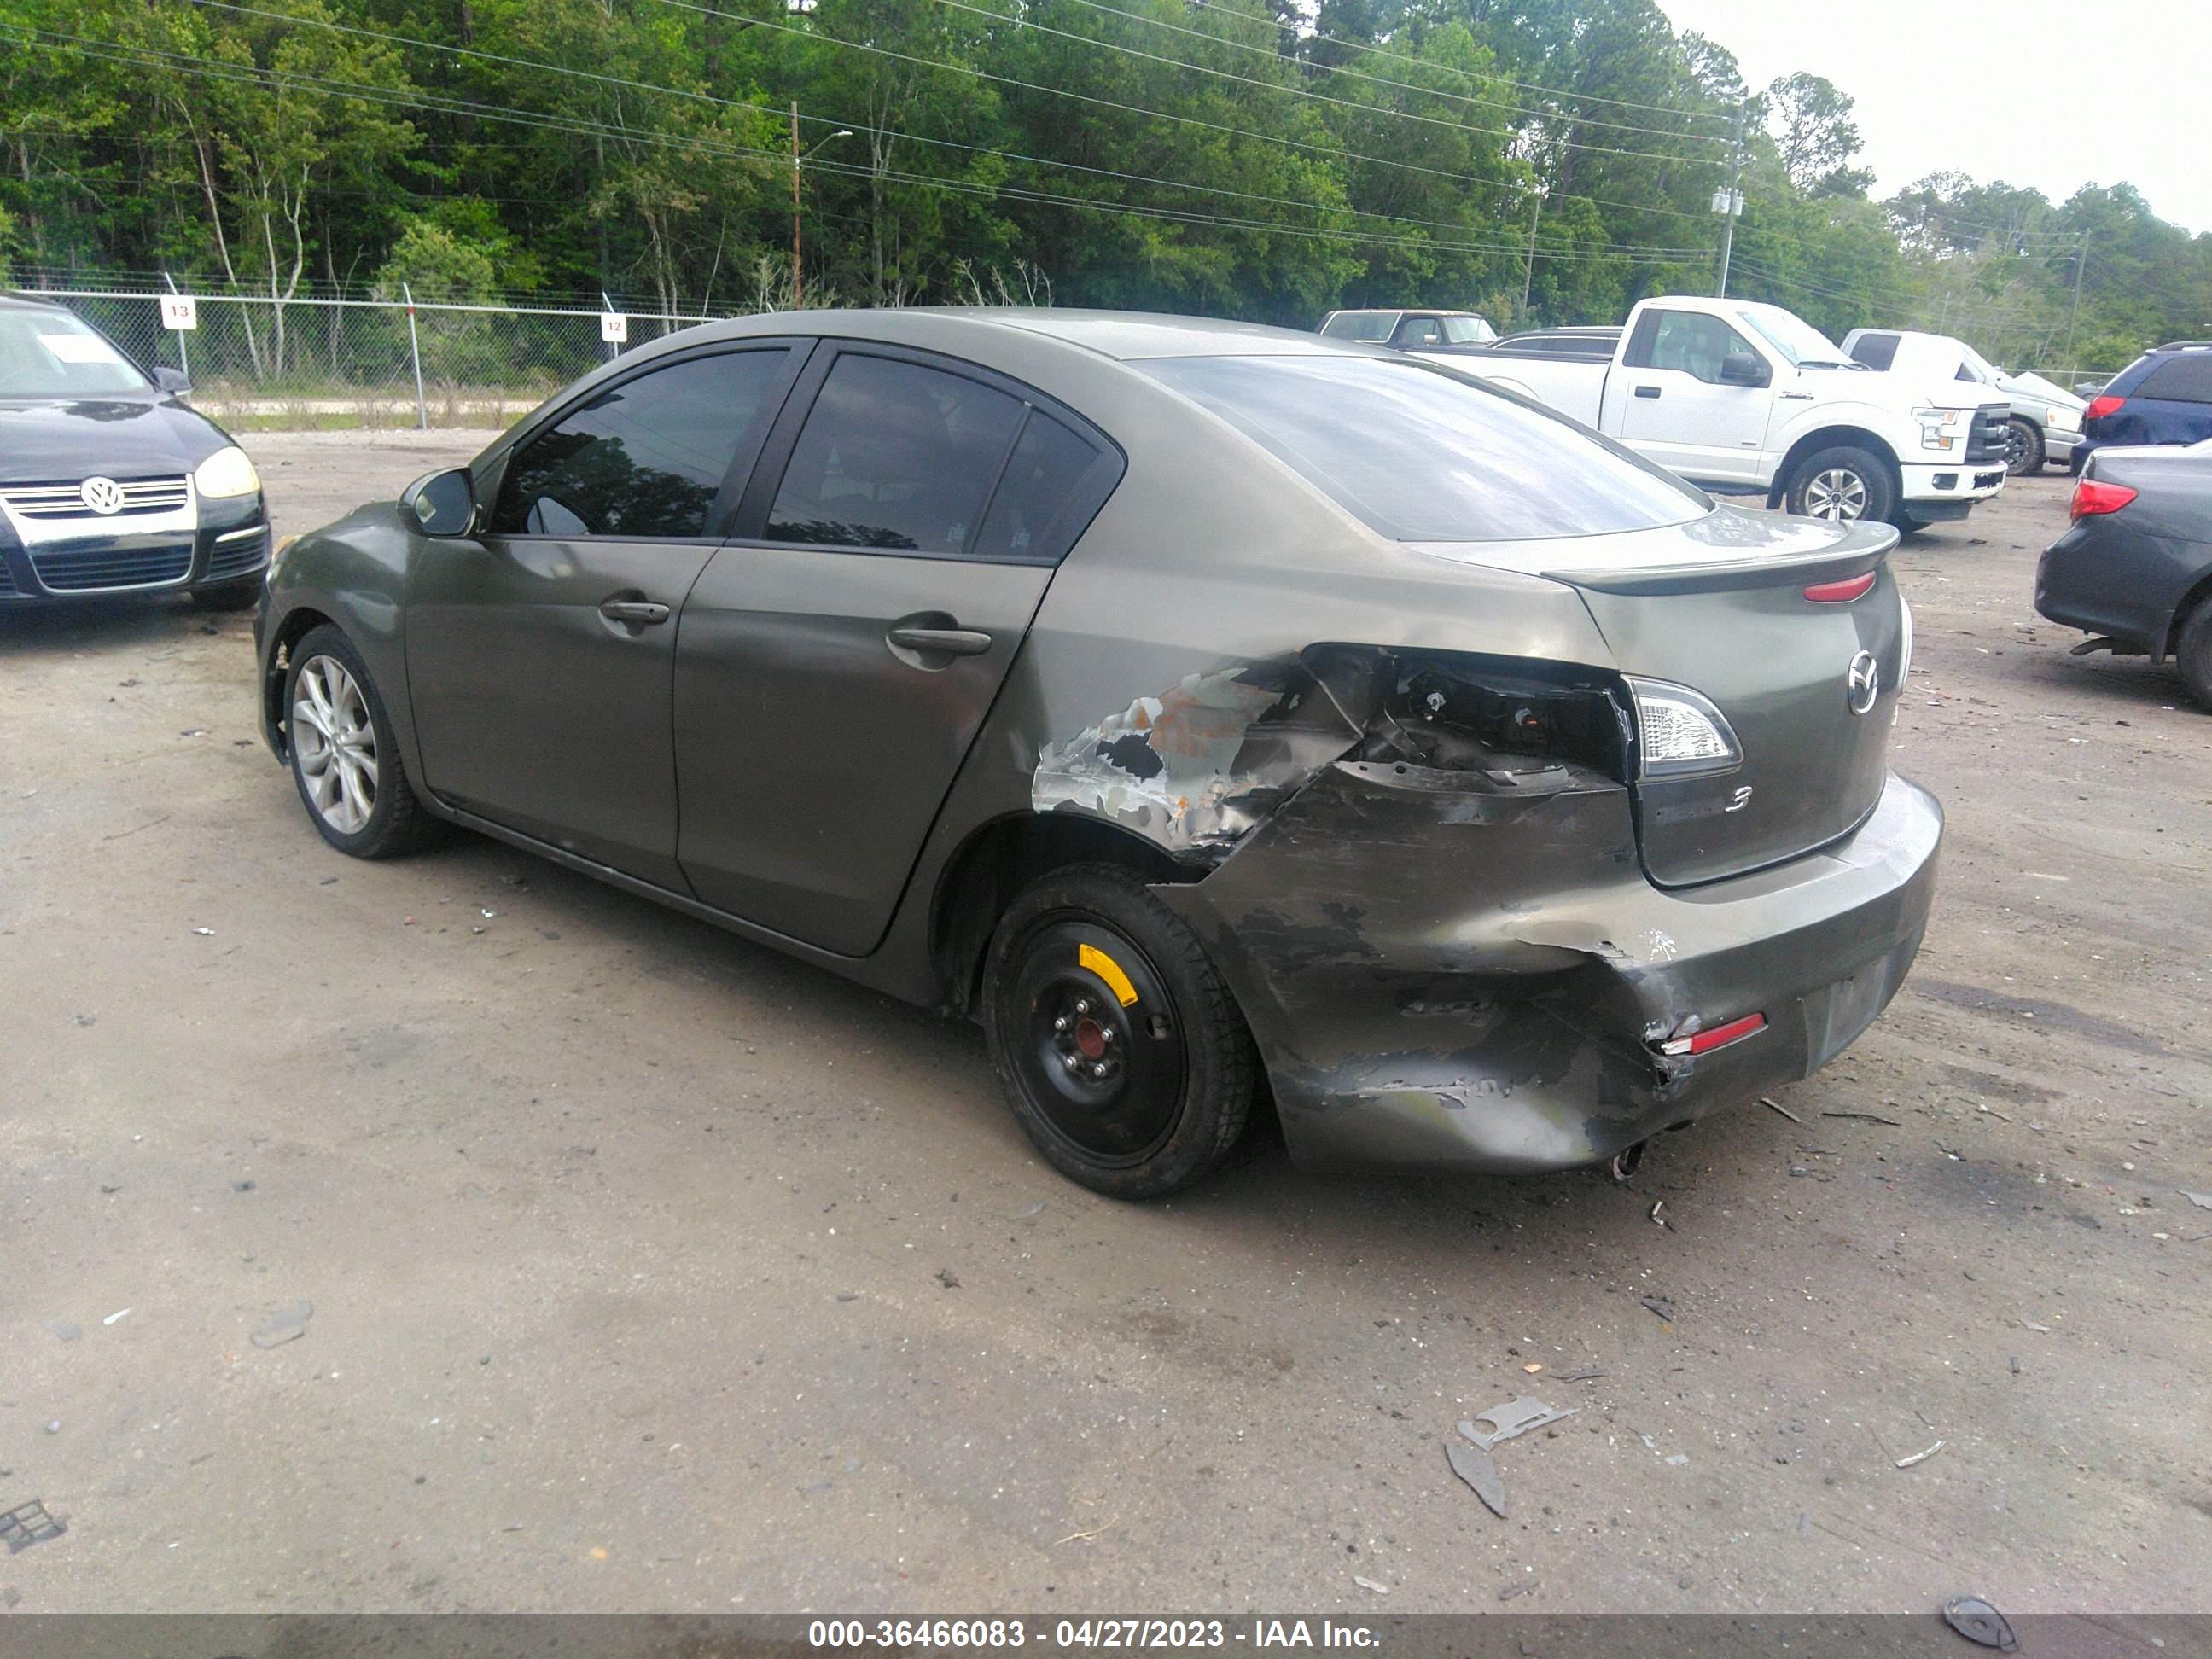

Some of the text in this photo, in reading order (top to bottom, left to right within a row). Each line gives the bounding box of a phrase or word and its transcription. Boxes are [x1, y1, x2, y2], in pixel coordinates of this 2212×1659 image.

[171, 306, 189, 317] 13
[608, 321, 621, 331] 12
[1725, 786, 1753, 812] 3
